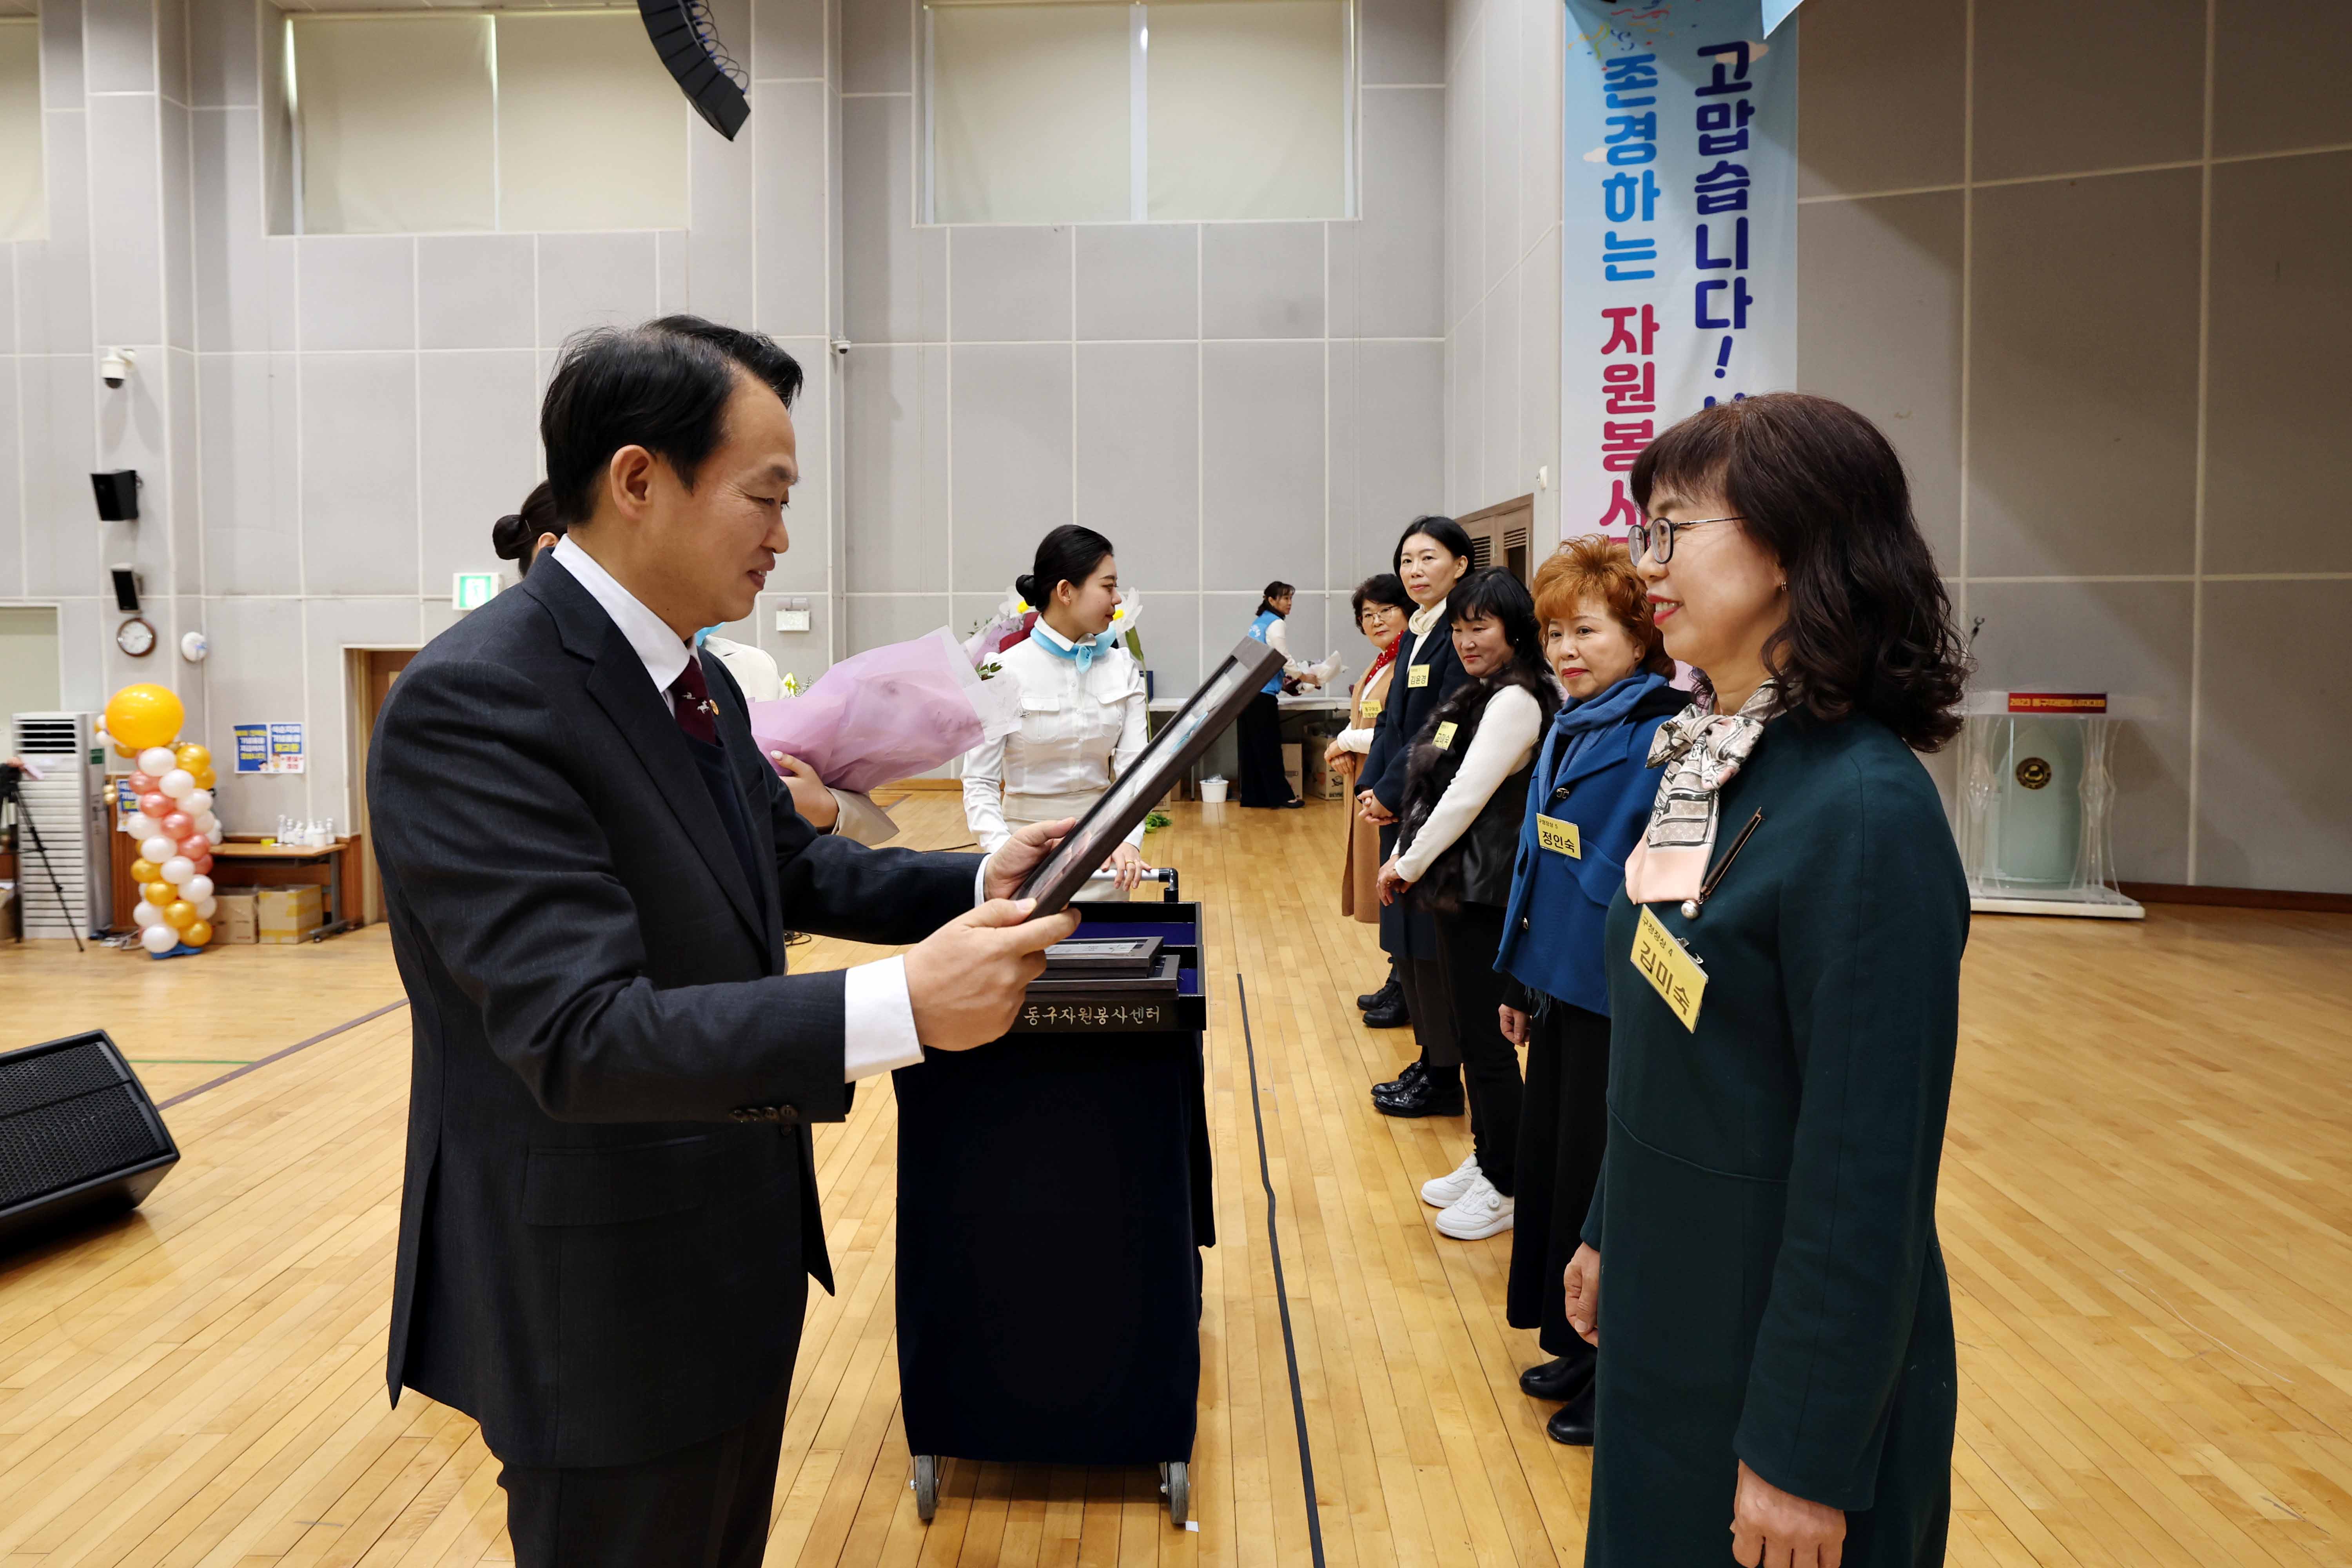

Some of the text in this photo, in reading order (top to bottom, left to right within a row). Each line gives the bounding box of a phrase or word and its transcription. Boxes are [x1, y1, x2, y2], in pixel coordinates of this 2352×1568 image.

[1602, 53, 1661, 281] 존경하는
[1694, 40, 1755, 379] 고맙습니다!
[1542, 831, 1575, 853] 정인숙
[1668, 949, 1673, 957] 4
[1640, 940, 1690, 1016] 김미숙
[1024, 1005, 1160, 1026] 동구자원봉사센터
